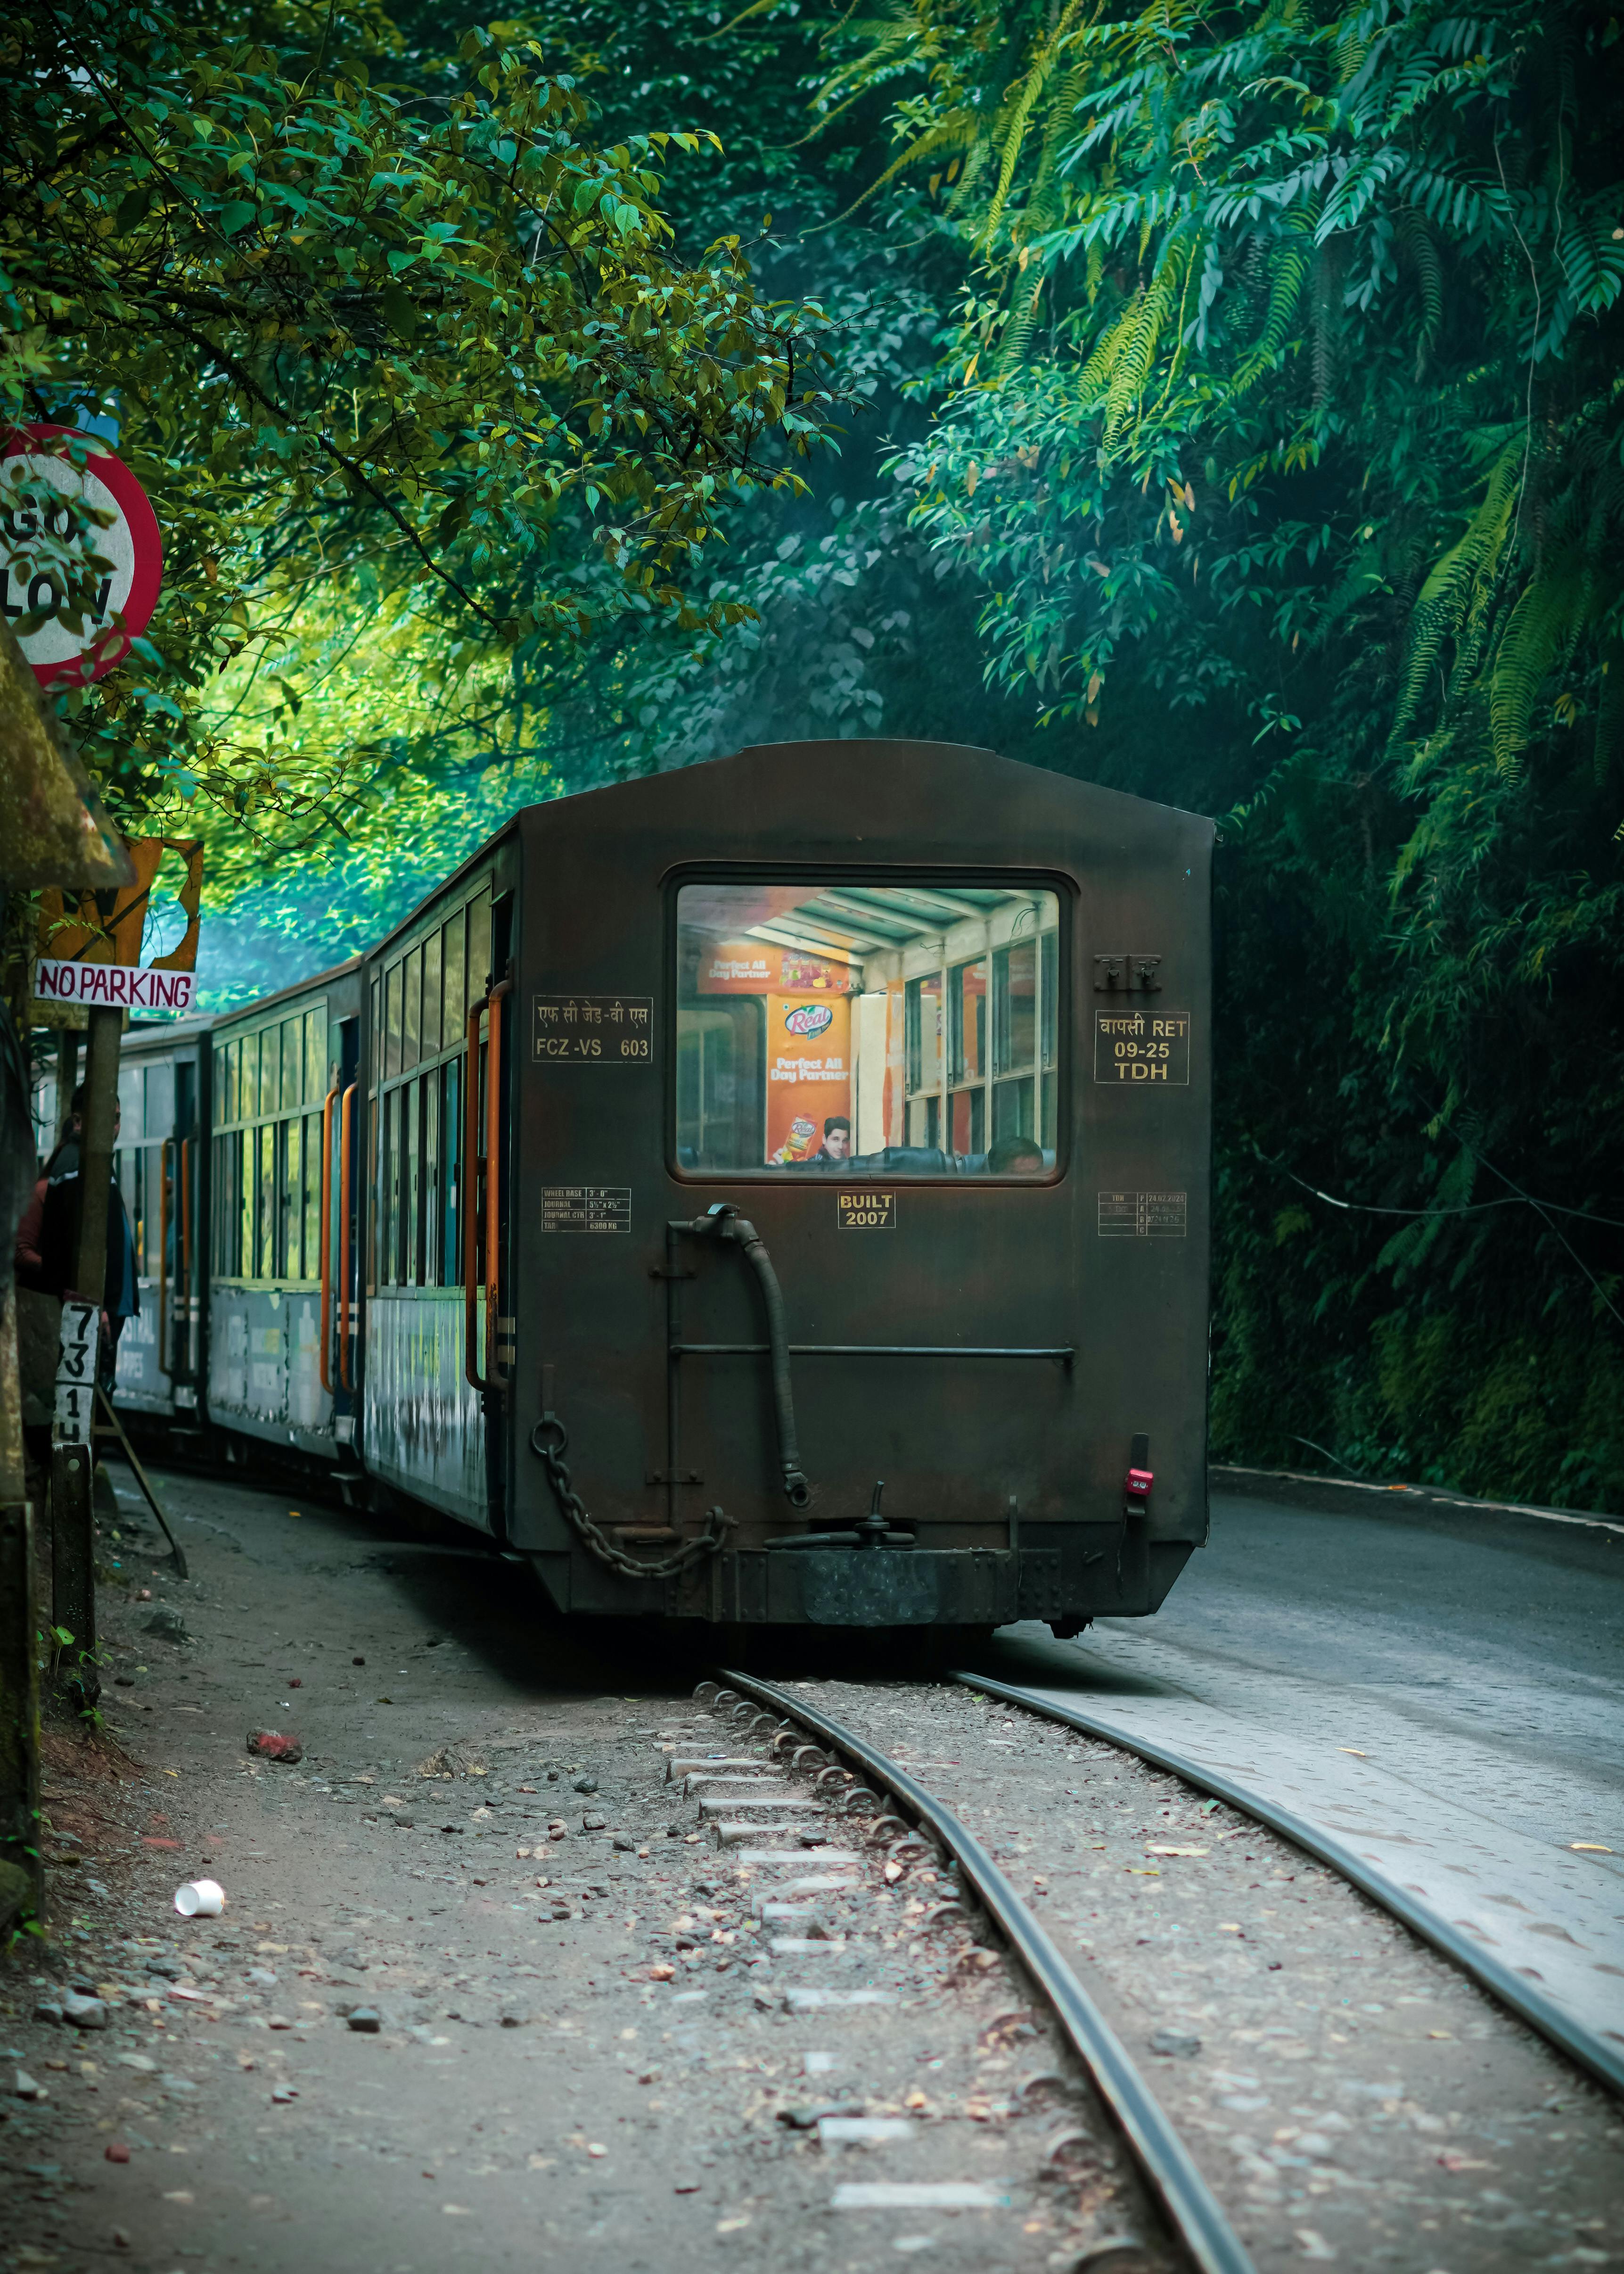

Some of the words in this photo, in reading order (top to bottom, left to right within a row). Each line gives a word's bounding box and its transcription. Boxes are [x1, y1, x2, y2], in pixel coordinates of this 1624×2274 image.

[4, 493, 78, 544] GO
[714, 960, 749, 970] Perfect
[752, 960, 766, 970] All
[709, 969, 730, 980] Day
[731, 969, 771, 978] Partner
[39, 966, 75, 997] NO
[80, 967, 191, 1008] PARKING
[790, 1007, 828, 1036] Real
[1099, 1013, 1145, 1036] वापसी
[1153, 1020, 1187, 1037] RET
[621, 1039, 648, 1056] 603
[1115, 1042, 1170, 1058] 09-25
[777, 1057, 822, 1069] Perfect
[825, 1057, 843, 1069] All
[1115, 1063, 1167, 1079] TDH
[771, 1069, 796, 1083] Day
[799, 1069, 848, 1080] Partner
[840, 1195, 893, 1208] BUILT
[846, 1211, 888, 1225] 2007
